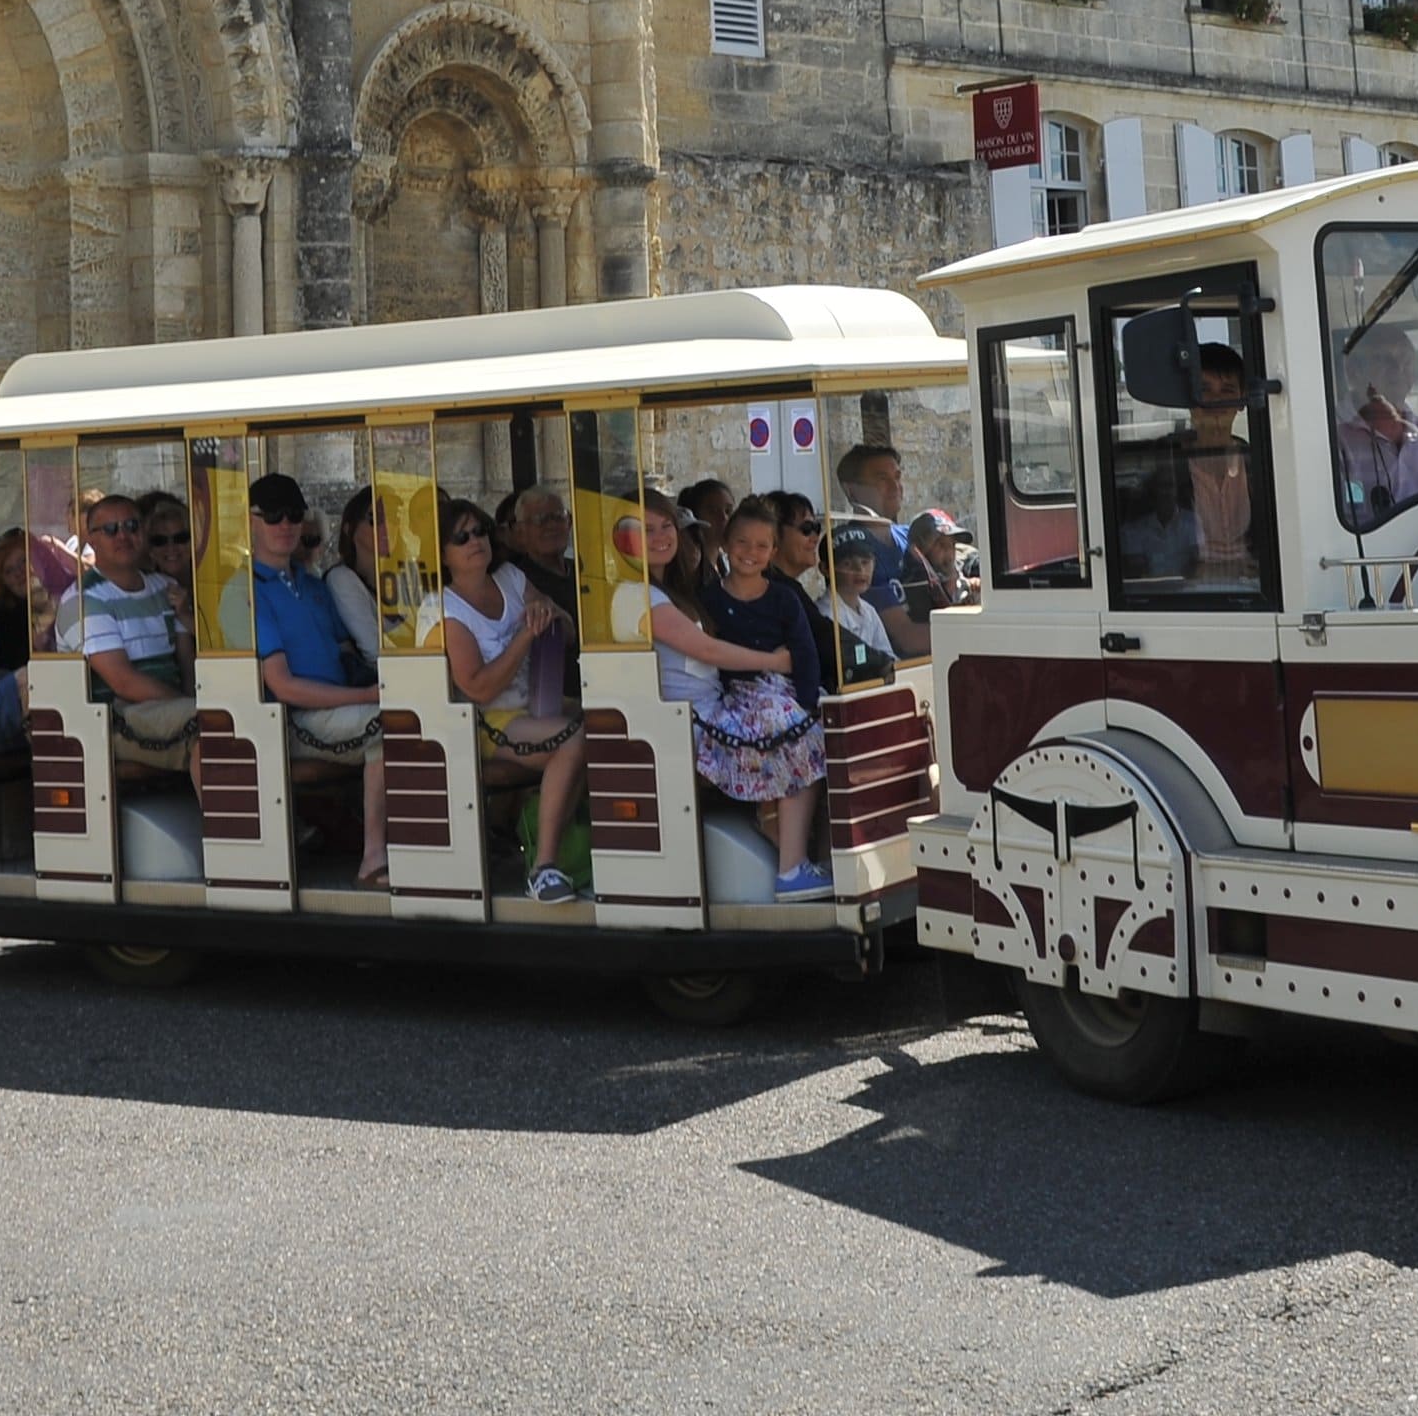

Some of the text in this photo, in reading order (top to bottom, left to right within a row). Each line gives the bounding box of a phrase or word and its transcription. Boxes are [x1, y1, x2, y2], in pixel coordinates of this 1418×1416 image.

[977, 132, 1034, 148] MAISON DU VIN
